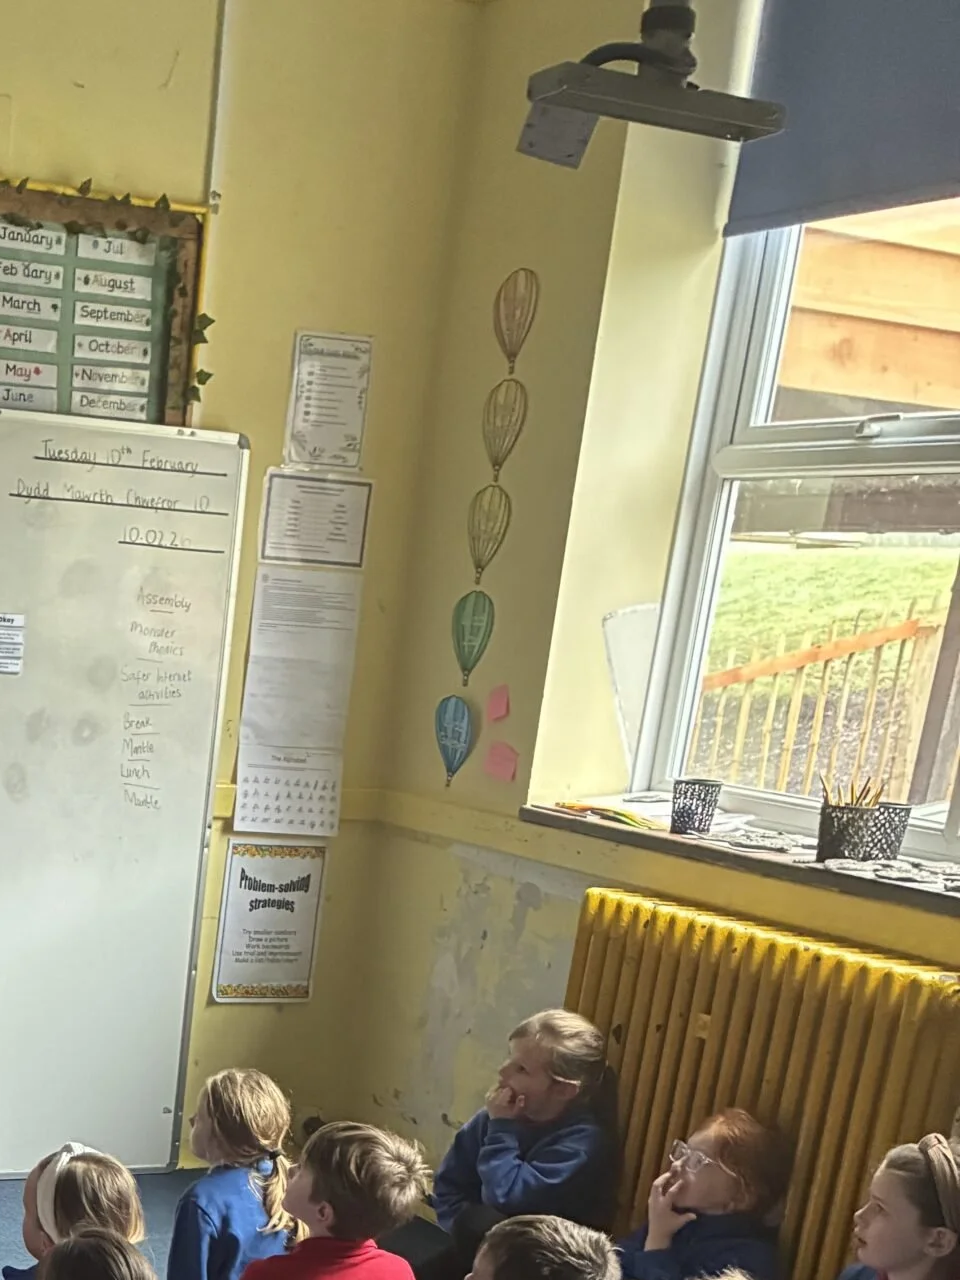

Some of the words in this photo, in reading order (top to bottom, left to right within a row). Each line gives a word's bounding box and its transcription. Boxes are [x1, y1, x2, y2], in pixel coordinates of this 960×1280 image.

[0, 227, 53, 249] January
[103, 240, 125, 256] Jul
[92, 274, 136, 292] August
[2, 295, 42, 312] March
[80, 305, 147, 323] September
[3, 328, 33, 345] April
[89, 338, 138, 355] October
[5, 363, 32, 382] May
[2, 389, 34, 402] June
[80, 394, 138, 412] December
[41, 439, 97, 472] Tuesday
[142, 449, 199, 477] February
[17, 478, 50, 504] Dydd
[64, 483, 114, 506] Mawrth
[126, 488, 180, 513] Chwefror
[194, 495, 210, 512] 10
[137, 586, 192, 612] Assembly
[121, 664, 152, 685] Safer
[157, 667, 192, 683] Internet
[123, 711, 153, 730] Break
[121, 763, 151, 779] Lunch
[239, 867, 312, 894] Problem-solving
[248, 897, 296, 913] strategies
